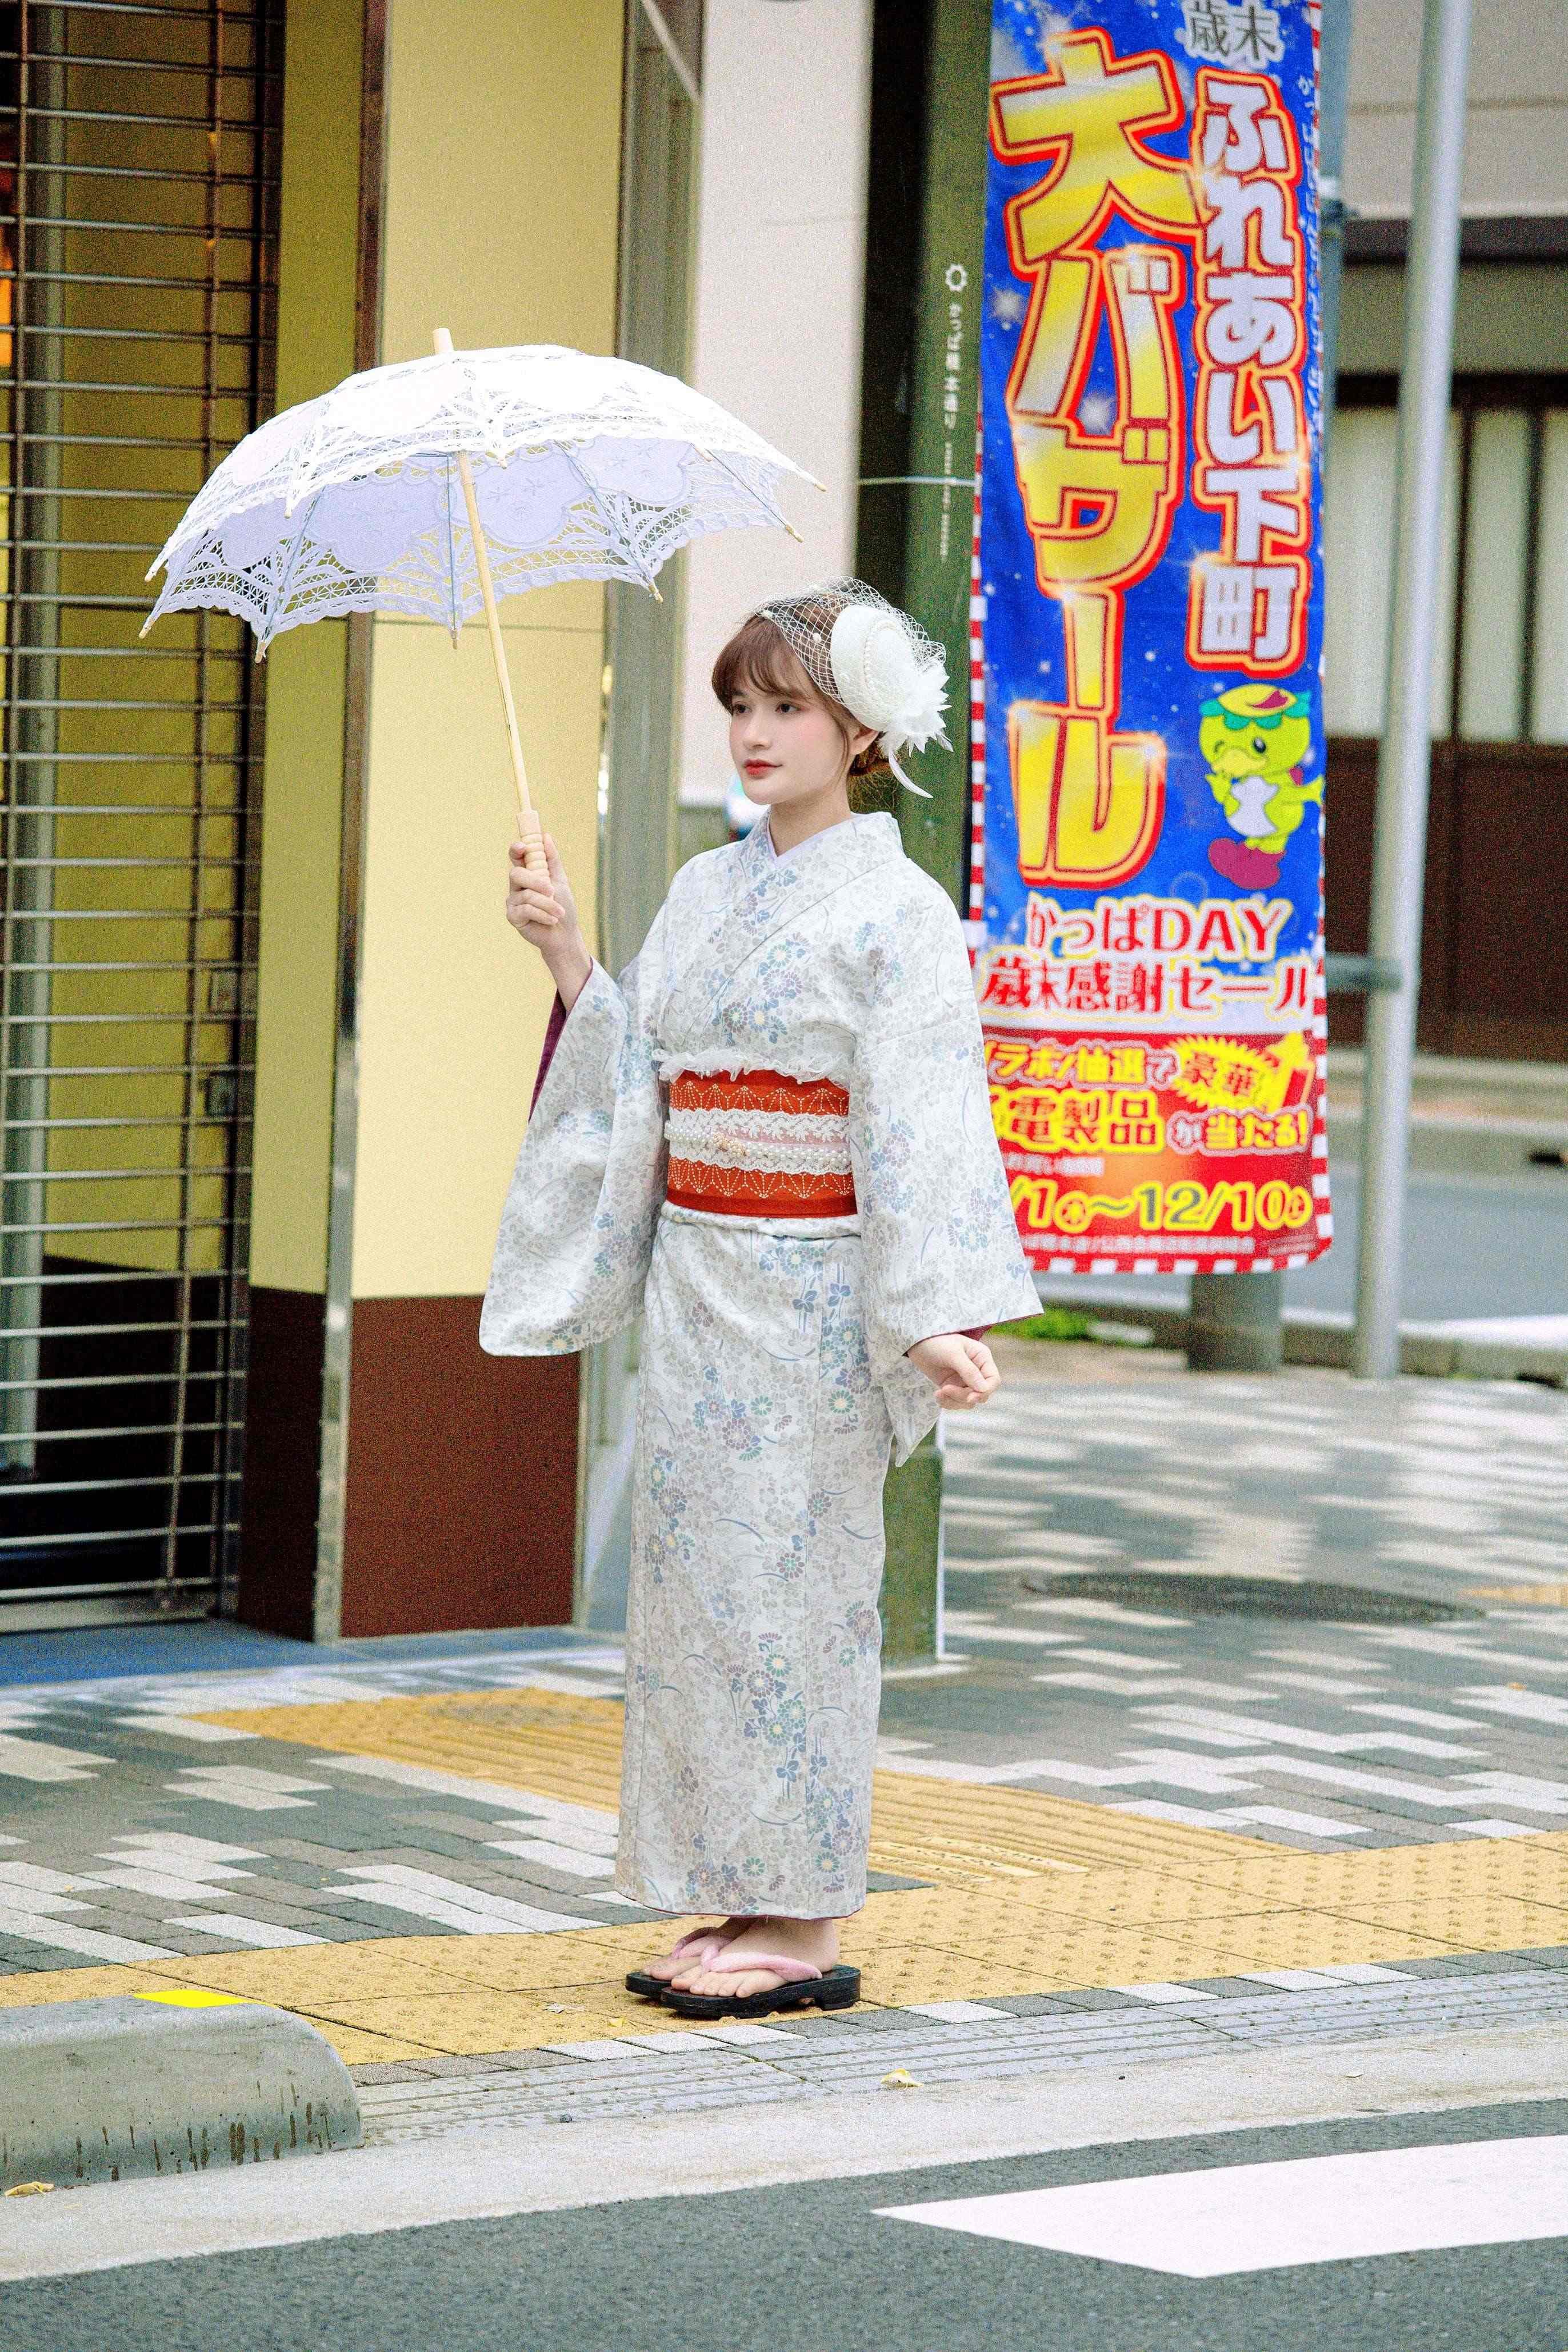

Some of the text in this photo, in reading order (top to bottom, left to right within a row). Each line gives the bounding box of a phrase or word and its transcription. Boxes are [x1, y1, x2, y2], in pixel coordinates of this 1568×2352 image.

[1190, 0, 1277, 60] 歳末
[1195, 76, 1302, 666] ふれあい下町
[991, 33, 1203, 880] 大バザール
[1030, 903, 1281, 951] かっぱDAY
[979, 955, 1306, 1013] 歳末感謝セール
[989, 1093, 1156, 1145] 電製品
